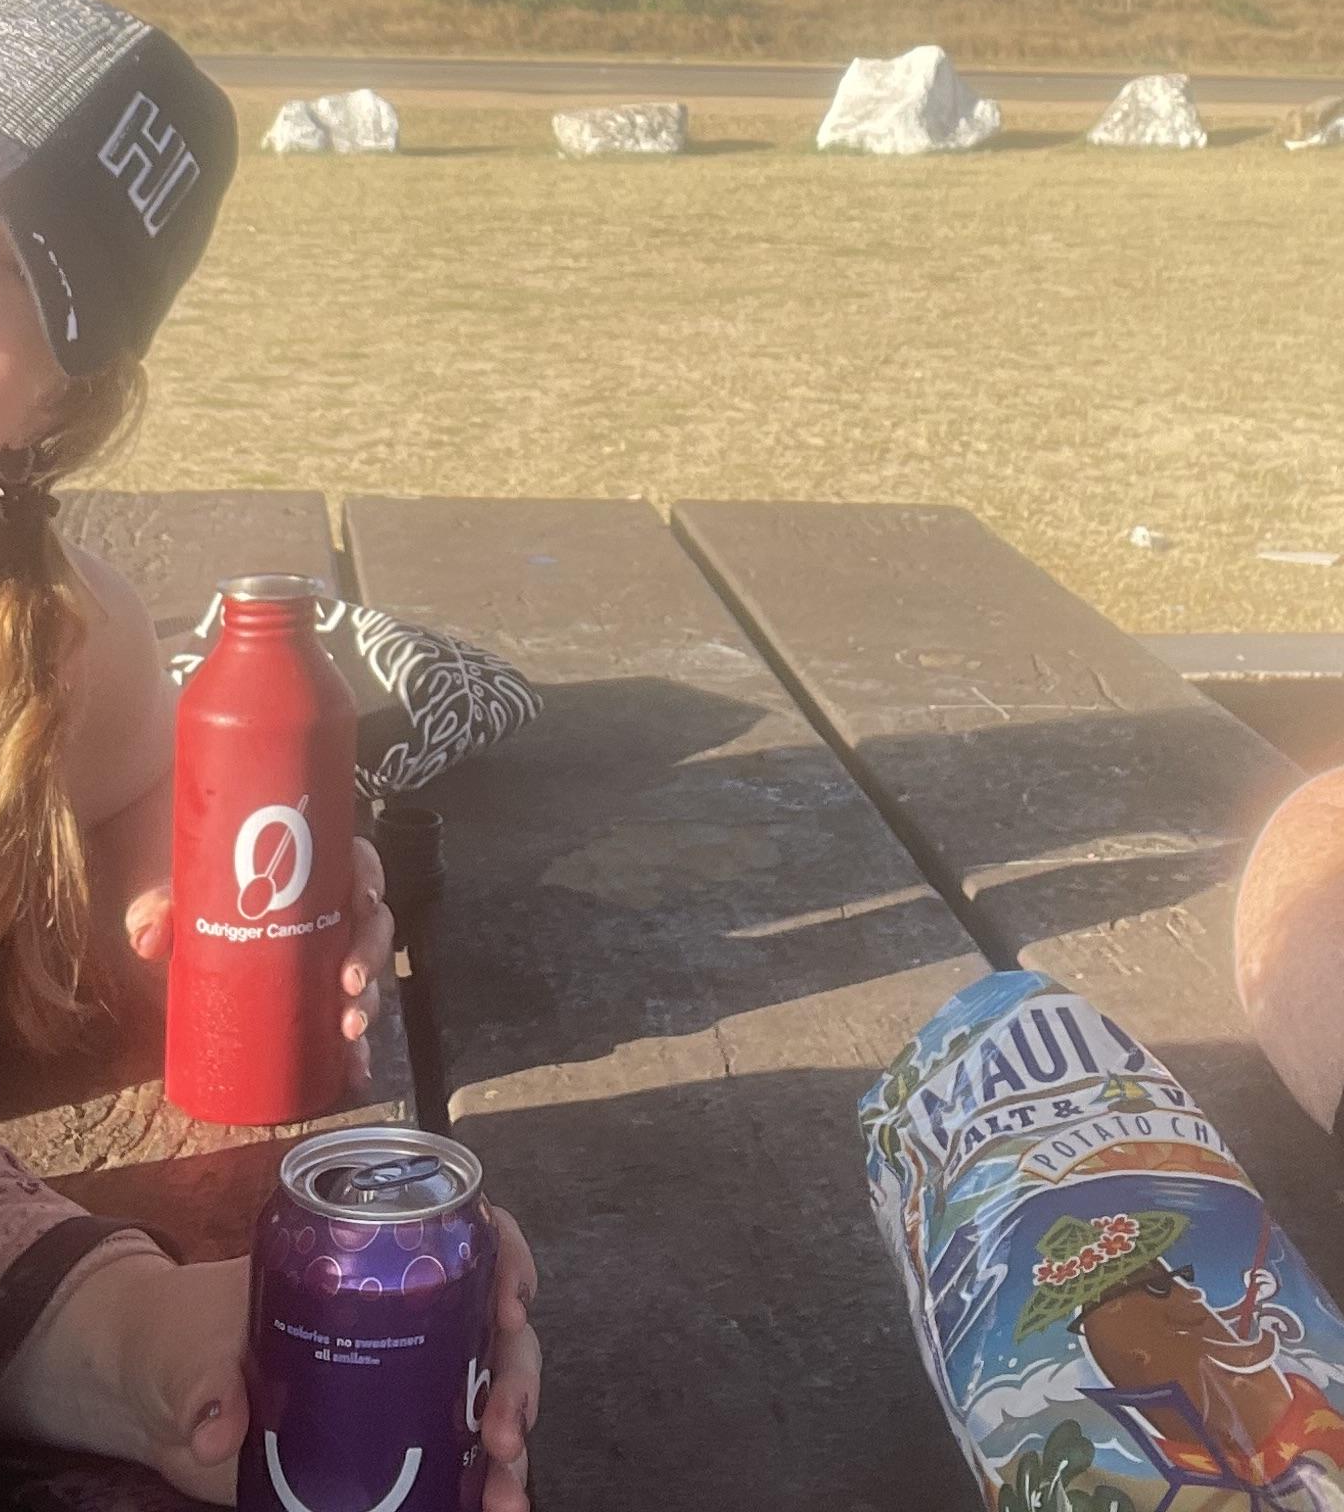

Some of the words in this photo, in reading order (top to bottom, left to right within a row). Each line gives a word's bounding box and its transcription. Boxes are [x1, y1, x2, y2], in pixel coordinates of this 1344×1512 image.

[196, 918, 264, 943] Outrigger
[267, 921, 314, 938] Canoe
[317, 910, 342, 929] Club
[920, 1006, 1100, 1151] MAUI
[1052, 1098, 1084, 1119] &
[1032, 1115, 1152, 1172] POTATO
[314, 1348, 331, 1362] all
[336, 1338, 352, 1348] no
